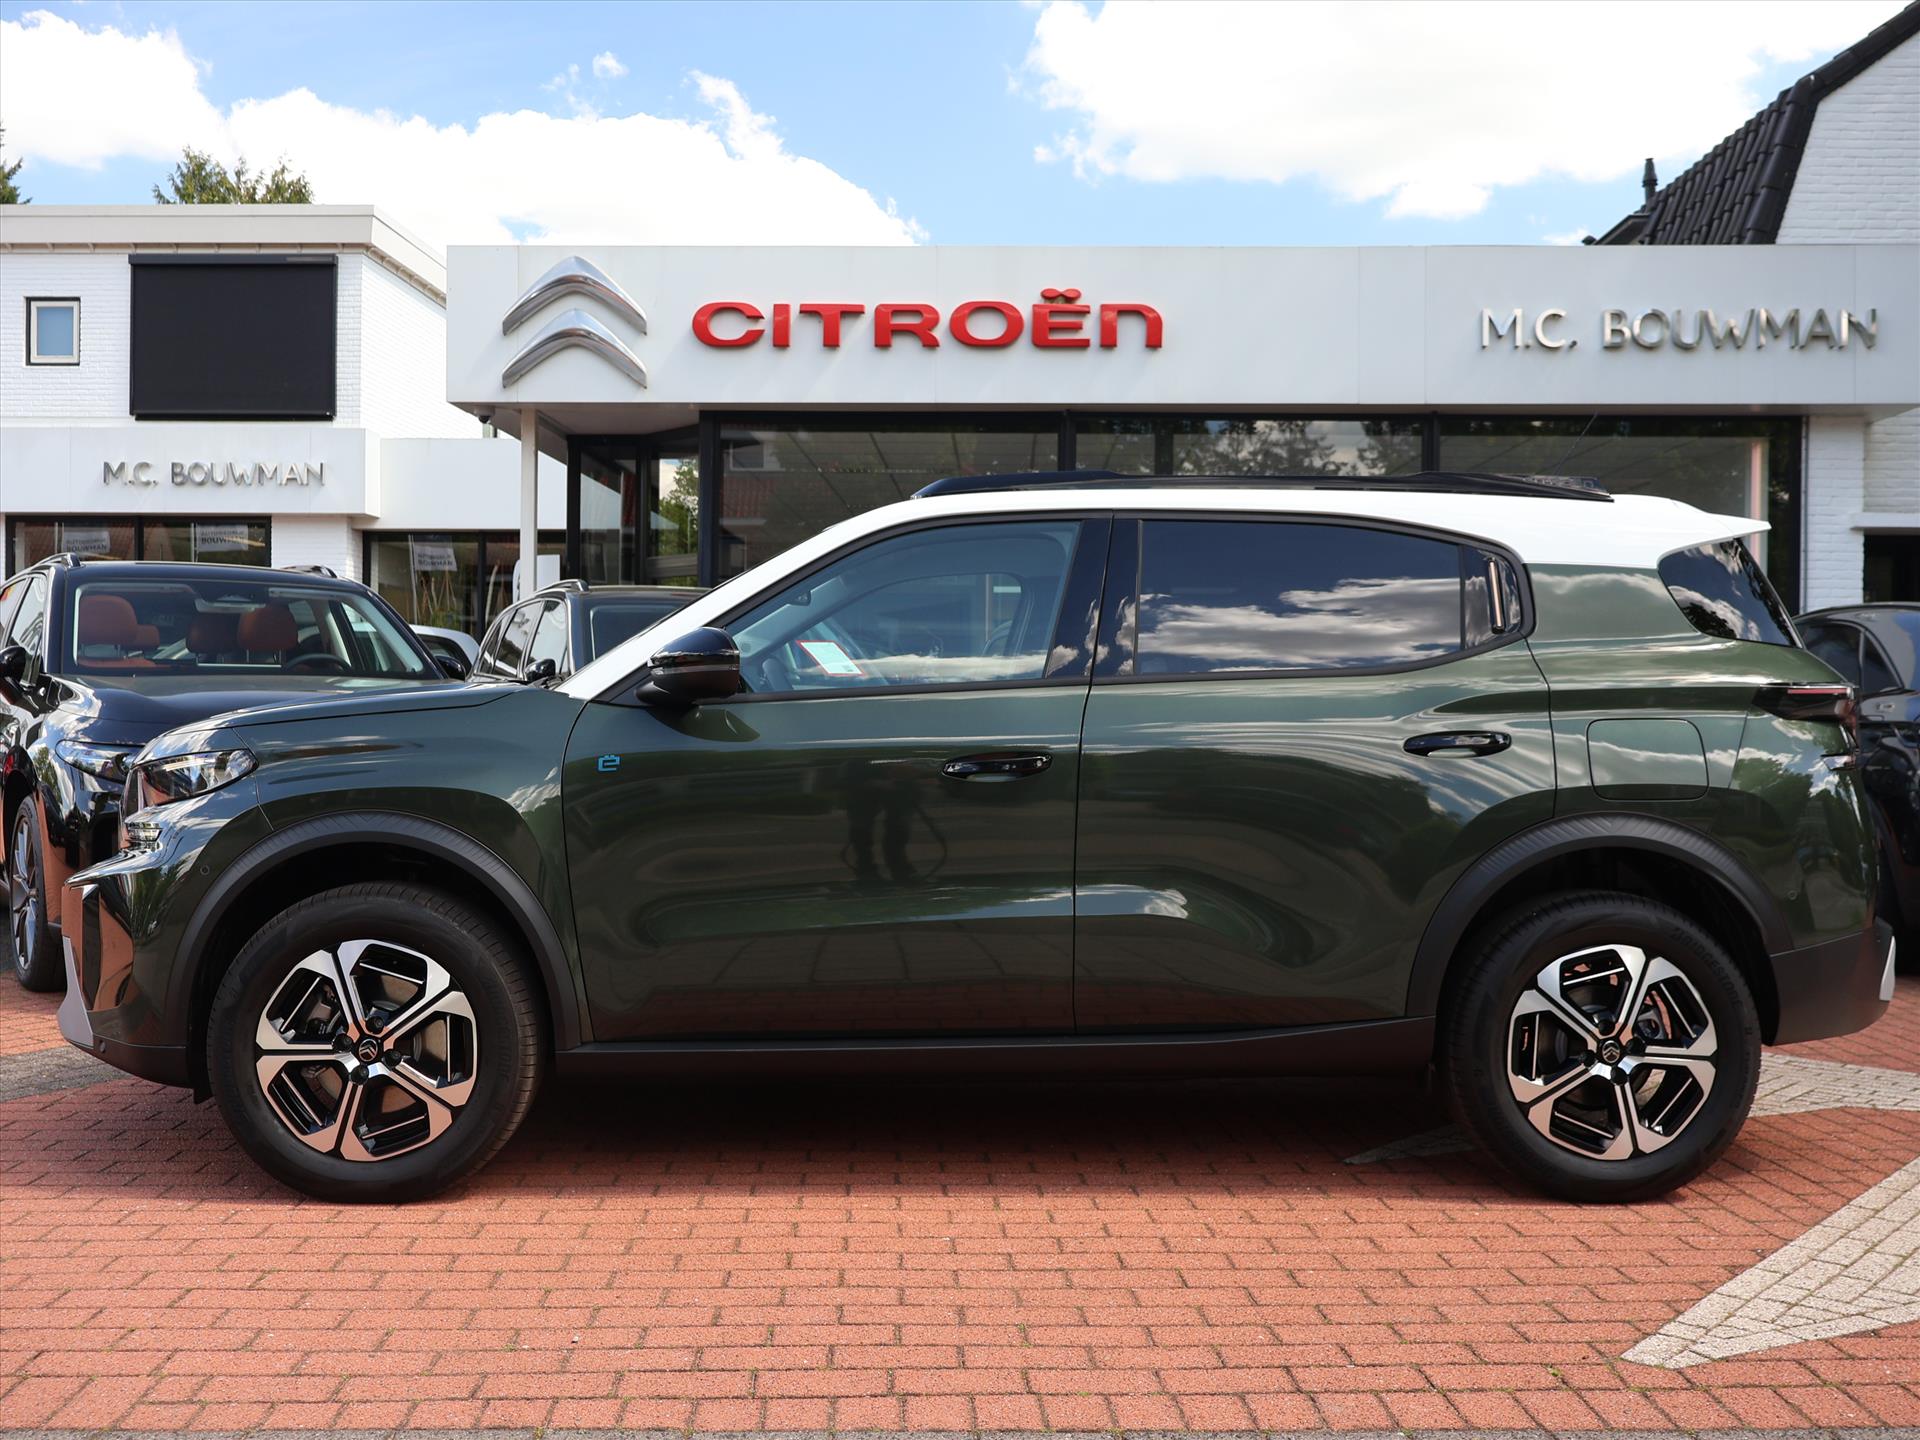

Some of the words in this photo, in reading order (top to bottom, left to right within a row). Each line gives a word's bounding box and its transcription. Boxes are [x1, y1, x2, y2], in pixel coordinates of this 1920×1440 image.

[691, 288, 1163, 348] CITROËN
[1481, 308, 1578, 350] M.C.
[1603, 308, 1878, 350] BOUWMAN
[103, 461, 158, 486] M.C.
[171, 461, 324, 487] BOUWMAN
